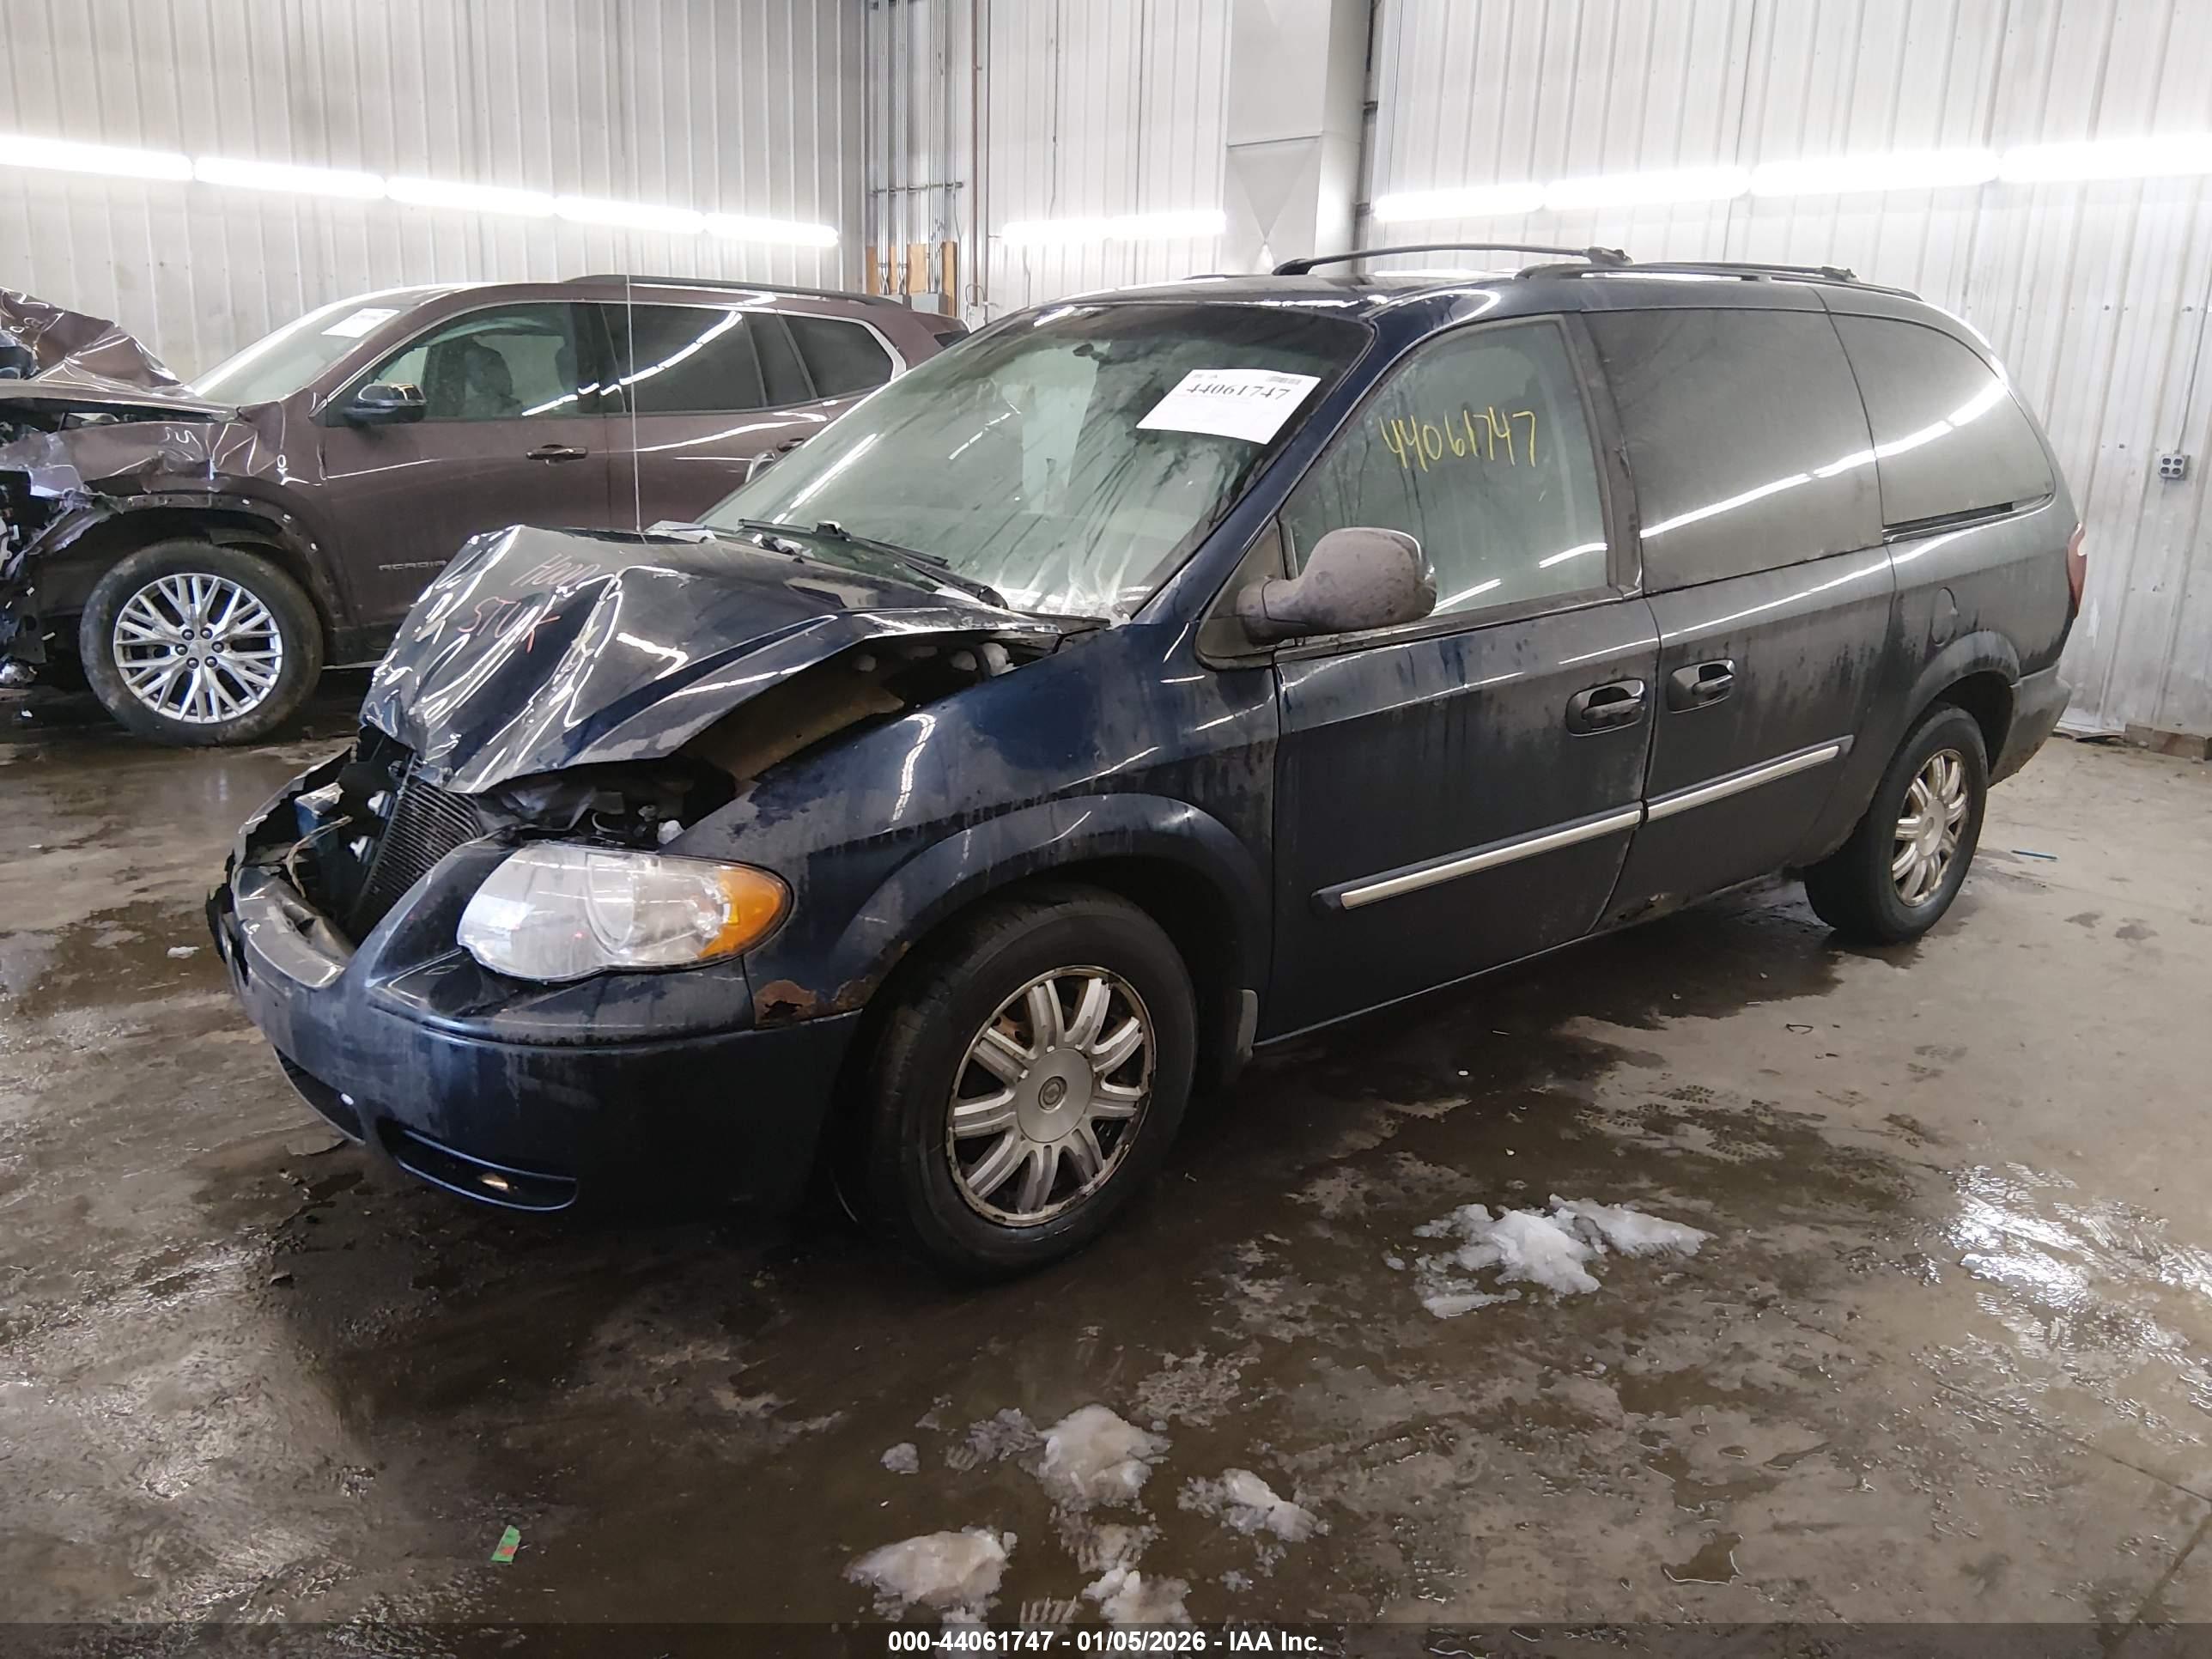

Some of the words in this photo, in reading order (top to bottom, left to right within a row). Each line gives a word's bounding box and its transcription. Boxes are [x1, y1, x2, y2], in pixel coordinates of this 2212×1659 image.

[1186, 382, 1291, 400] 44061747
[1378, 405, 1536, 473] 44061747
[378, 560, 447, 571] ACADIA
